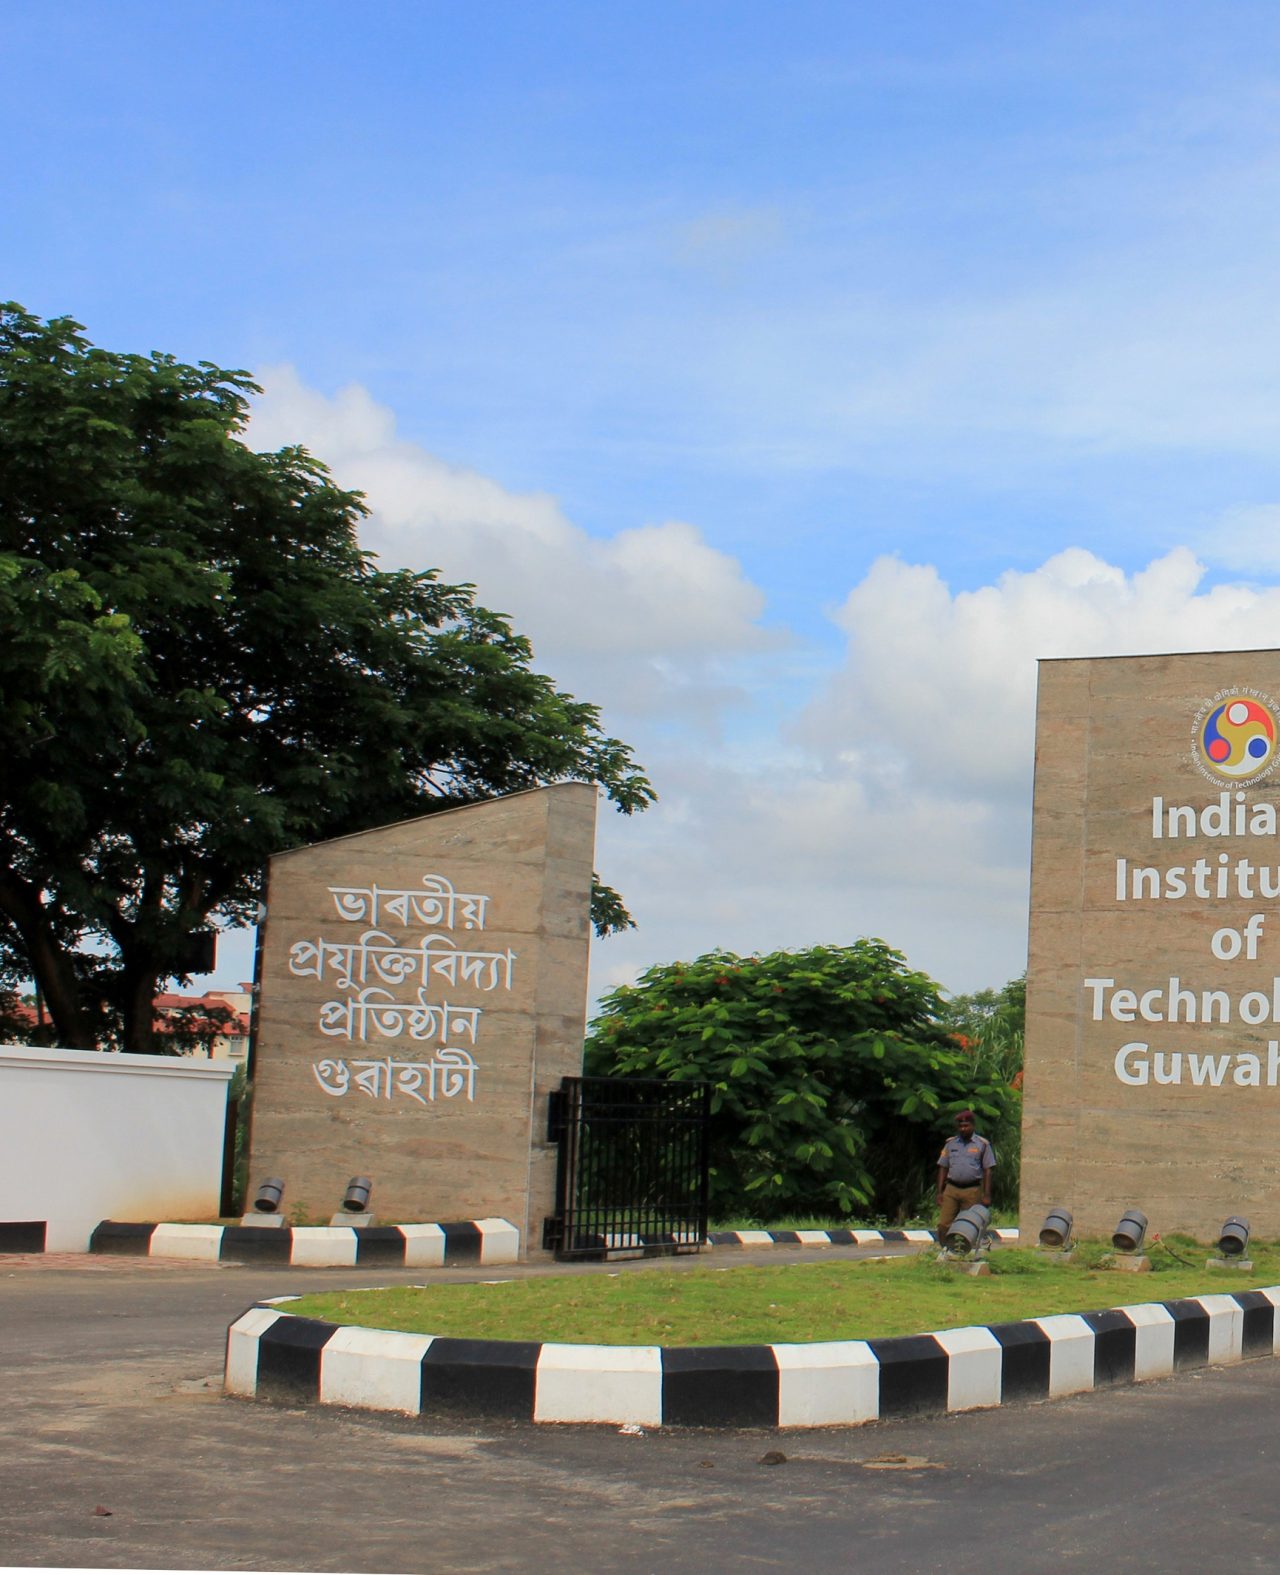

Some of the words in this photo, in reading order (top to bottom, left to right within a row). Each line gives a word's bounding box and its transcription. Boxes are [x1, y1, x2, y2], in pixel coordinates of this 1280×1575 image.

[1191, 742, 1202, 767] Indian
[1199, 765, 1225, 788] Institute
[1225, 781, 1233, 790] of
[1235, 766, 1274, 789] Technology
[328, 873, 490, 930] ভাৰতীয়
[1211, 913, 1265, 960] of
[312, 1047, 480, 1104] গুৱাহাটী
